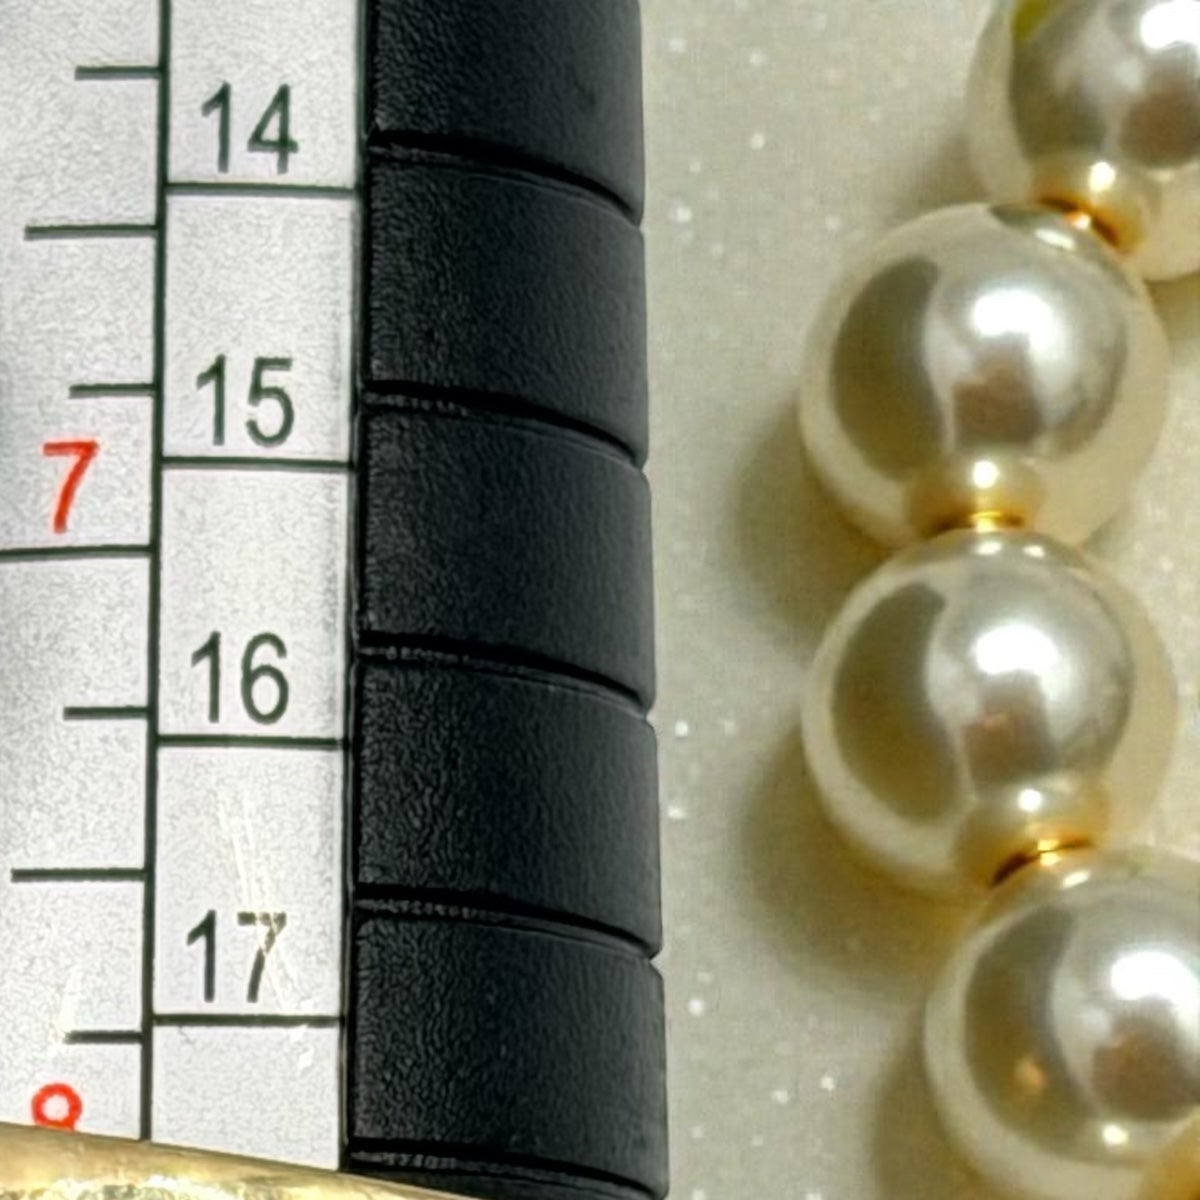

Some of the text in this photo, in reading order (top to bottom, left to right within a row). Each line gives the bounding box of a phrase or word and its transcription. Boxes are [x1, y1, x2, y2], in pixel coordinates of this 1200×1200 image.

[202, 83, 299, 174] 14
[196, 353, 294, 446] 15
[41, 437, 99, 534] 7
[192, 632, 290, 722] 16
[187, 909, 287, 1003] 17
